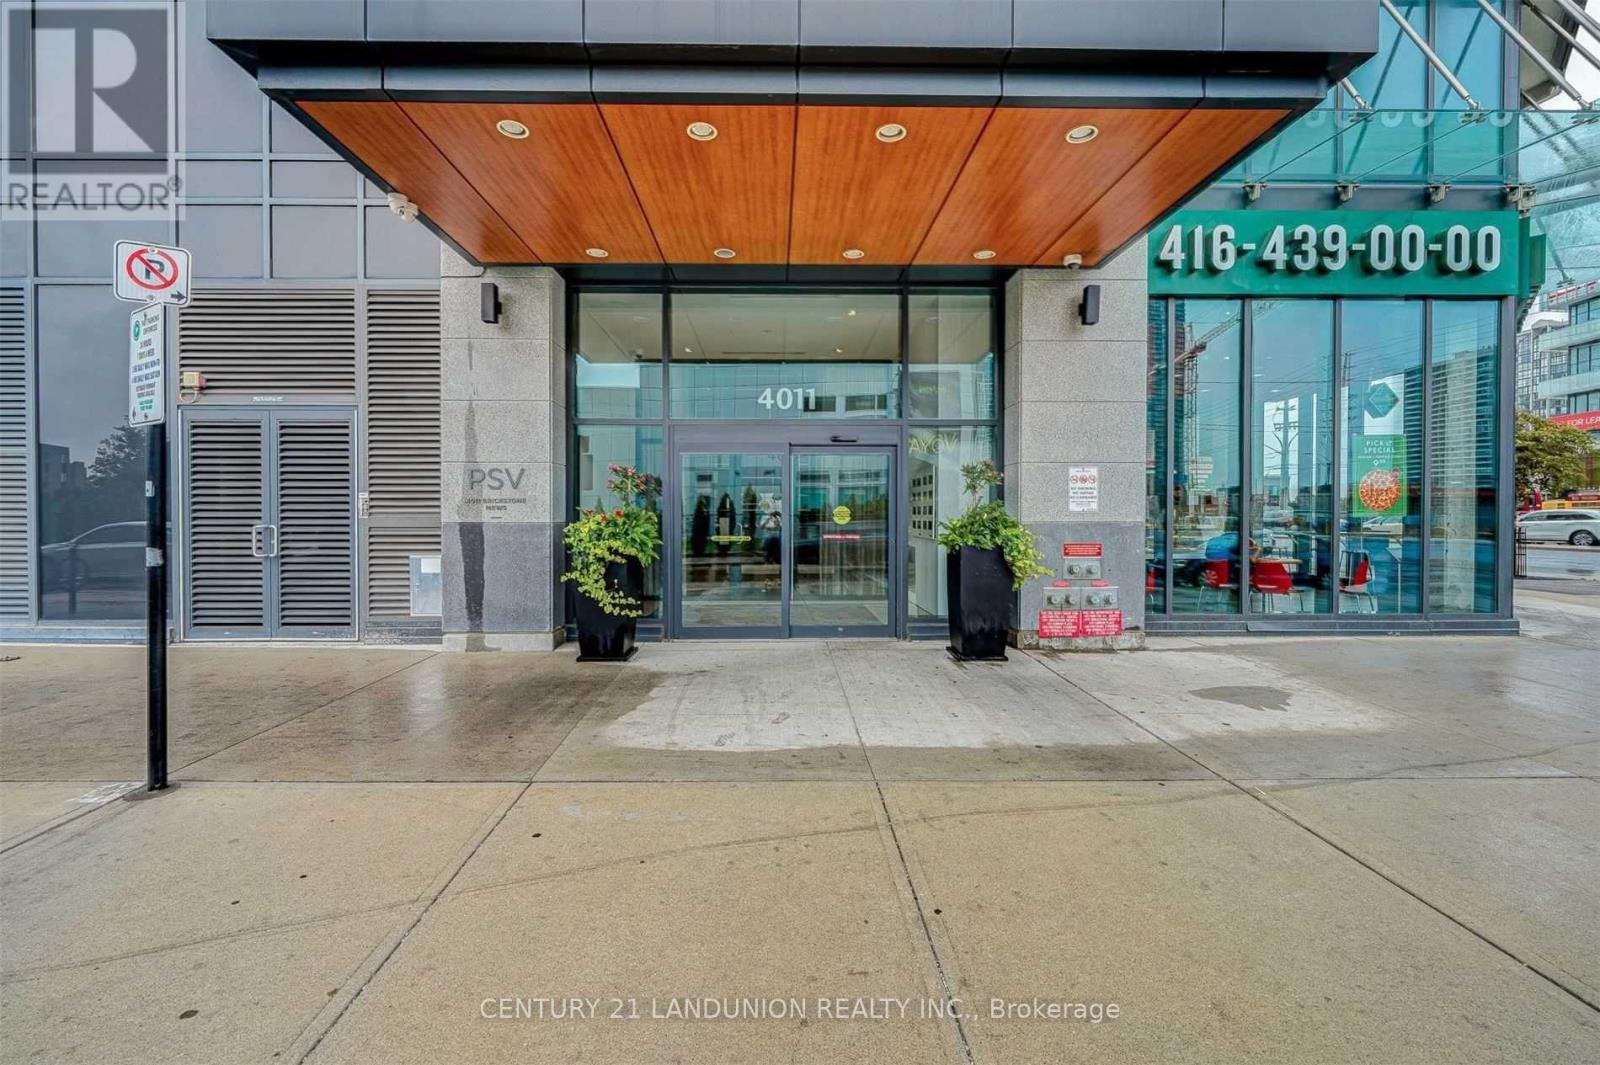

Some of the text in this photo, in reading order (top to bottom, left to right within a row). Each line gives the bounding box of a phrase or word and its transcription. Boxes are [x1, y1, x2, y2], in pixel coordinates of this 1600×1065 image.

[1159, 224, 1501, 272] 416-439-00-00
[757, 386, 816, 410] 4011
[1364, 446, 1395, 454] SPECIAL
[1366, 439, 1384, 447] PICK
[470, 467, 526, 491] PSV
